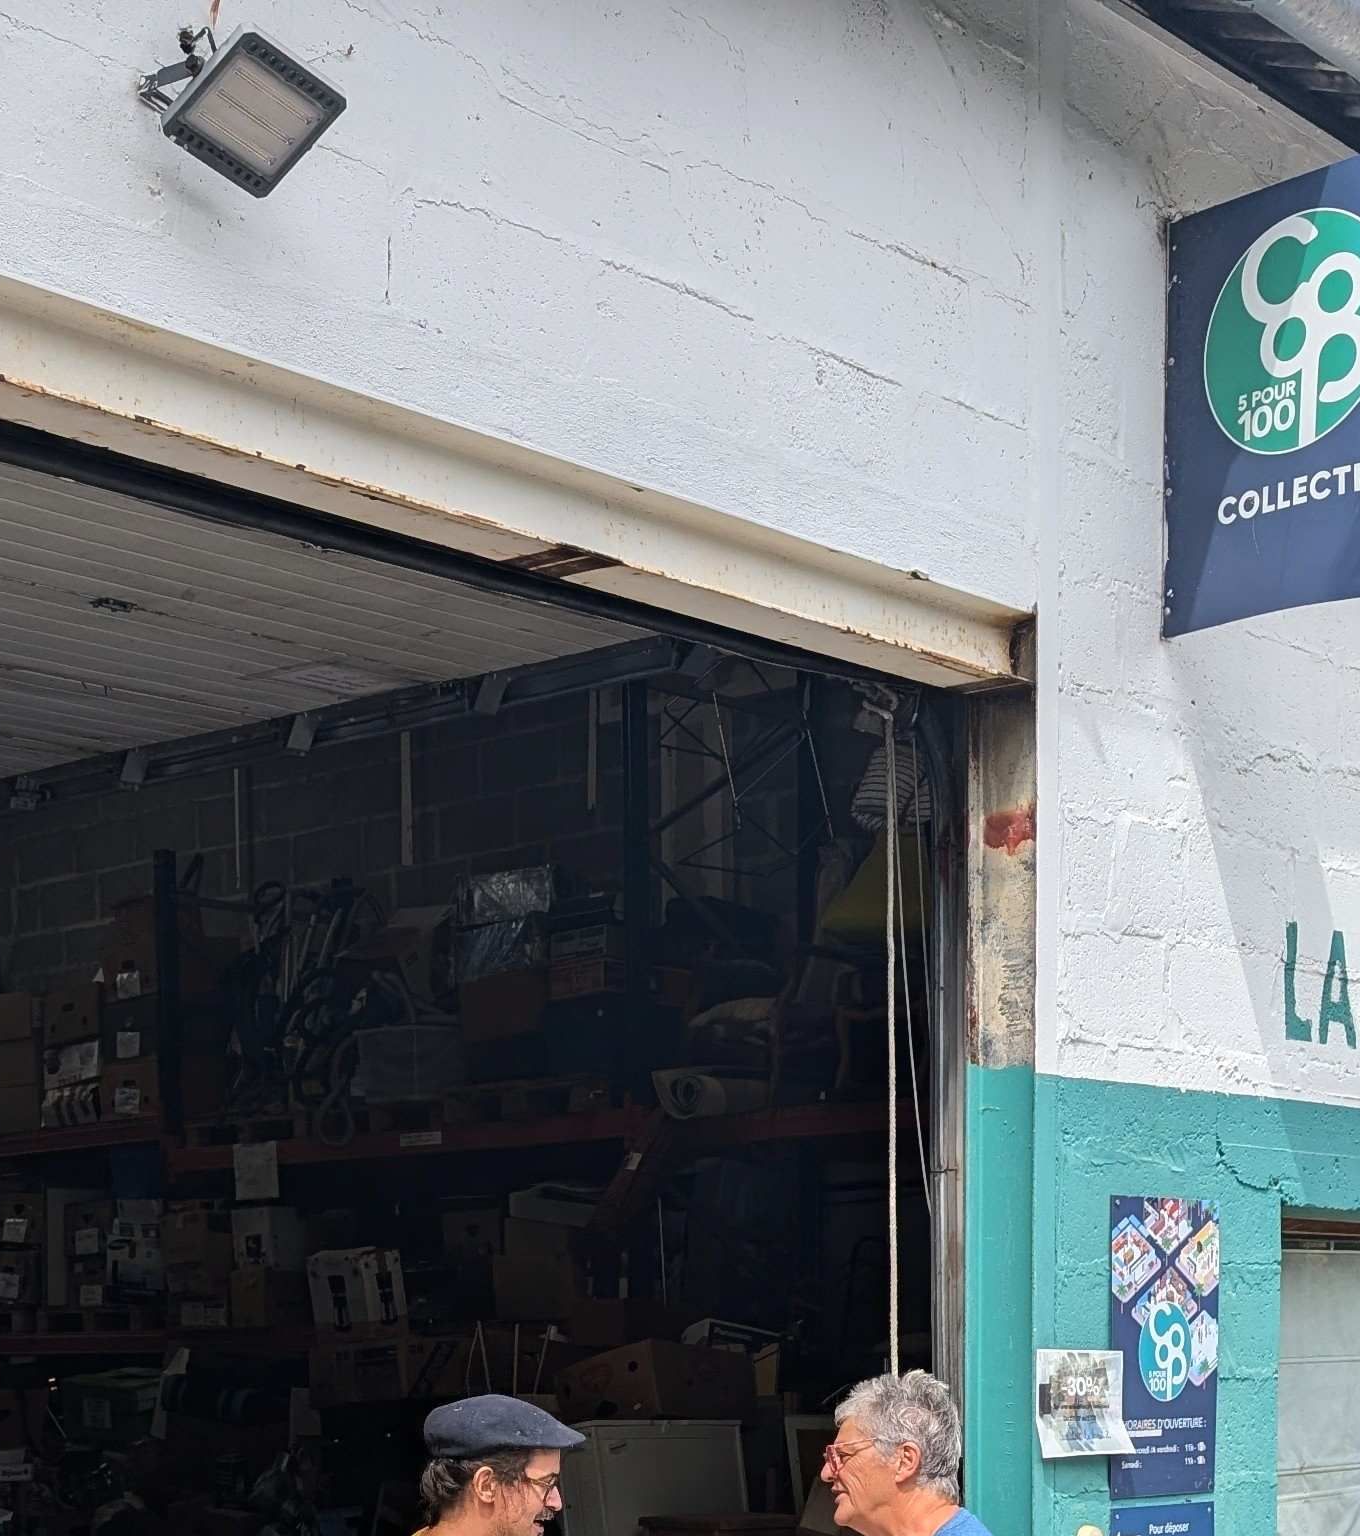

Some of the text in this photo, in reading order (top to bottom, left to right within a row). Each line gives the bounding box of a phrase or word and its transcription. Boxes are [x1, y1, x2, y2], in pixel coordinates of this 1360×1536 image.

[1238, 380, 1296, 411] 5 POUR
[1237, 399, 1296, 442] 100
[1284, 921, 1357, 1049] LA
[1153, 1370, 1167, 1378] POUR
[1061, 1376, 1100, 1397] -30%
[1148, 1378, 1167, 1392] 100
[1148, 1522, 1190, 1535] Pour déposer
